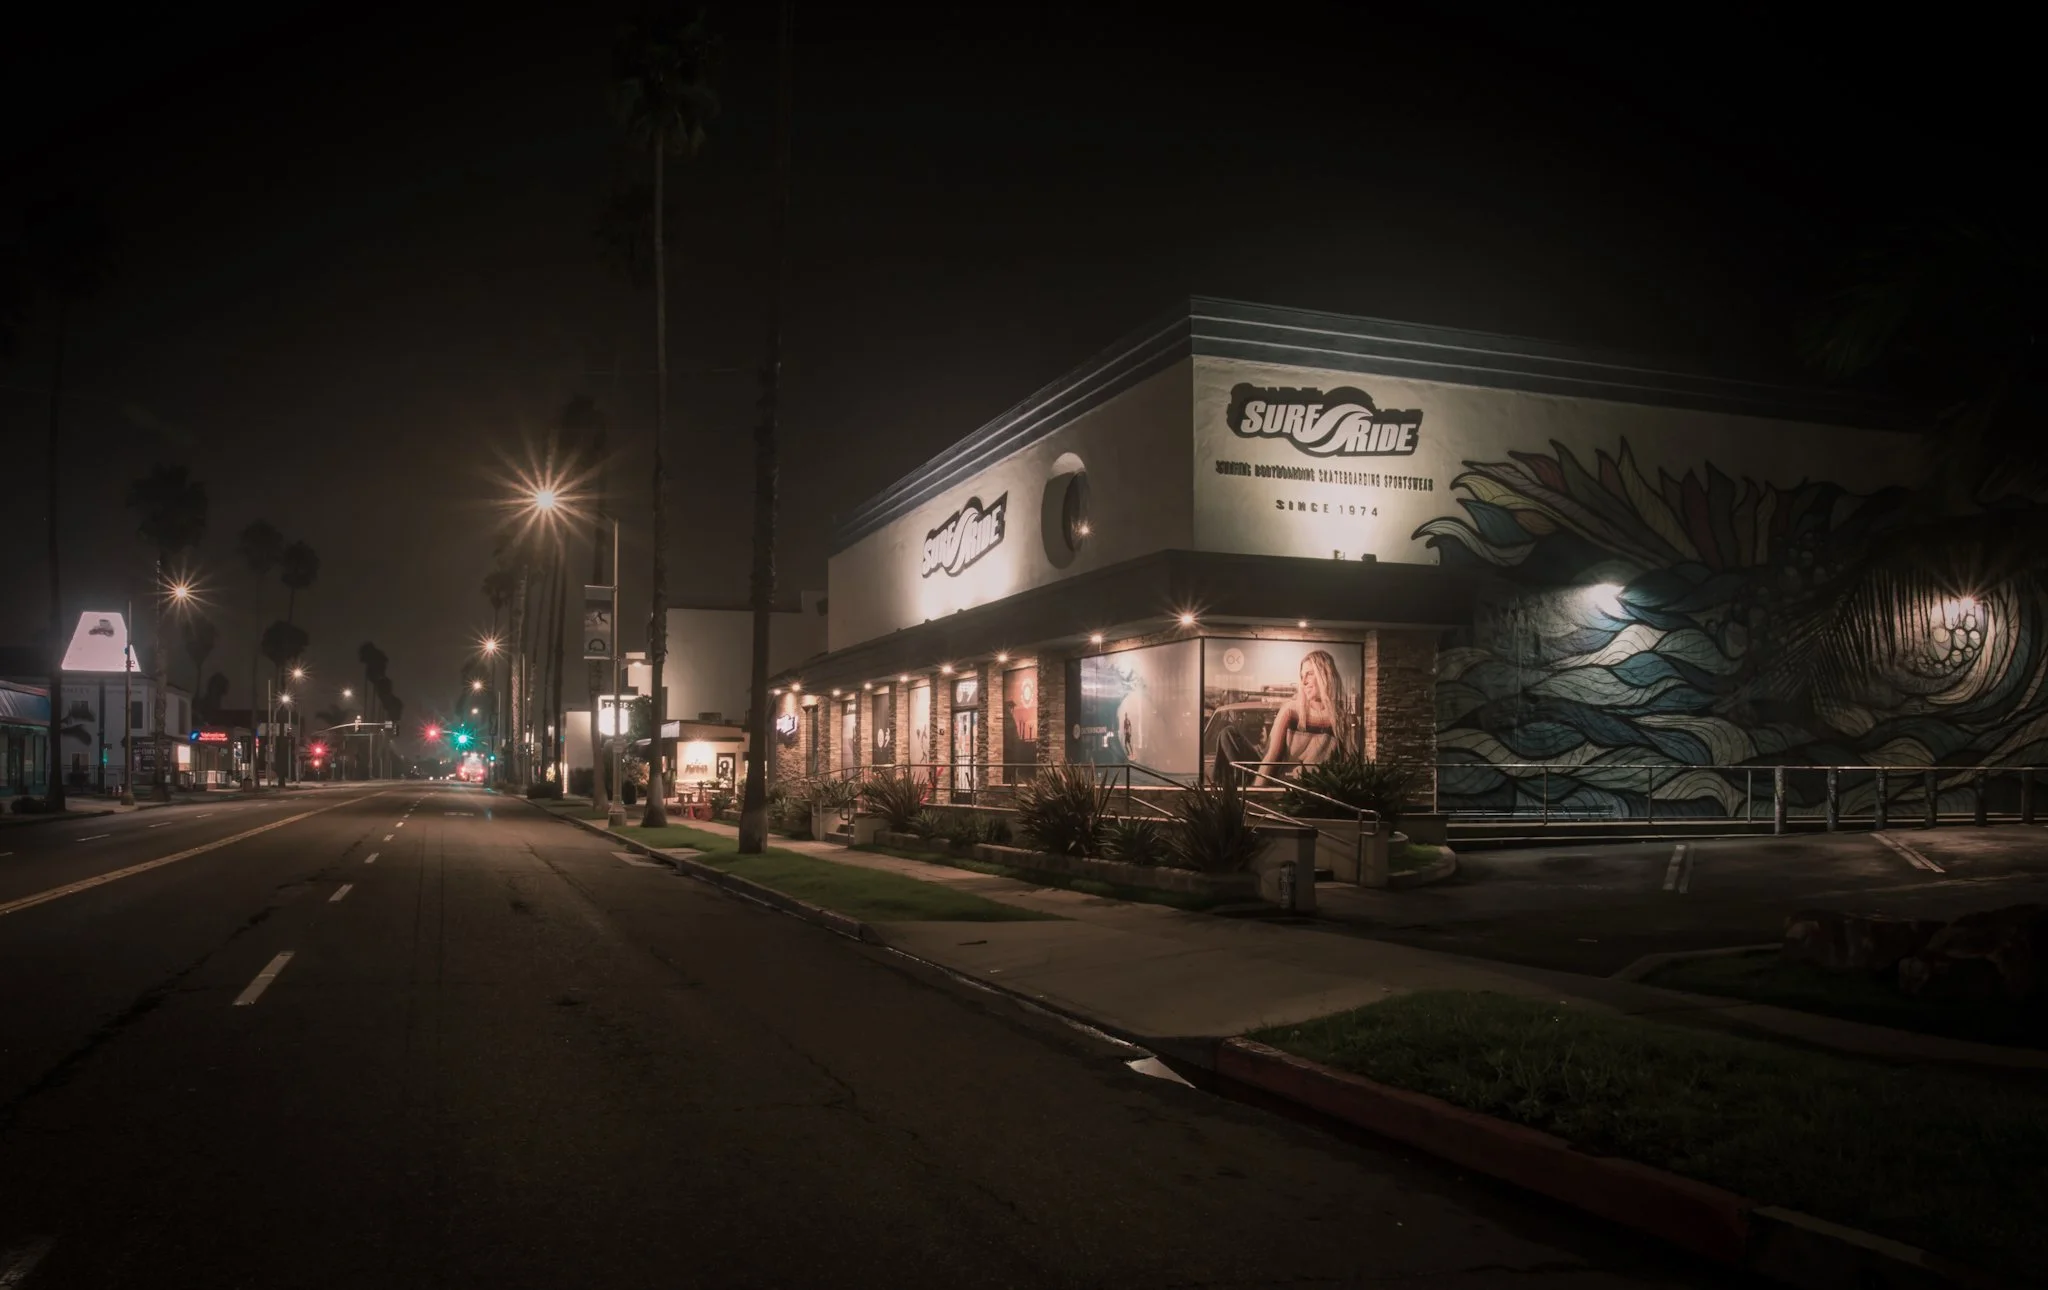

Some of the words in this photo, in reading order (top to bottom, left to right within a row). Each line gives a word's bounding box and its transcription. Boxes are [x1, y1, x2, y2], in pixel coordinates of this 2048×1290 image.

[1240, 401, 1329, 440] SURF
[1343, 414, 1417, 452] RIDE
[1215, 460, 1252, 477] SURFING
[1254, 464, 1316, 482] BODYBOARDING
[1319, 468, 1380, 488] SKATEBOARDING
[1383, 474, 1434, 492] SPORTSWEAR
[1276, 499, 1329, 513] SINCE
[1339, 504, 1378, 517] 1974
